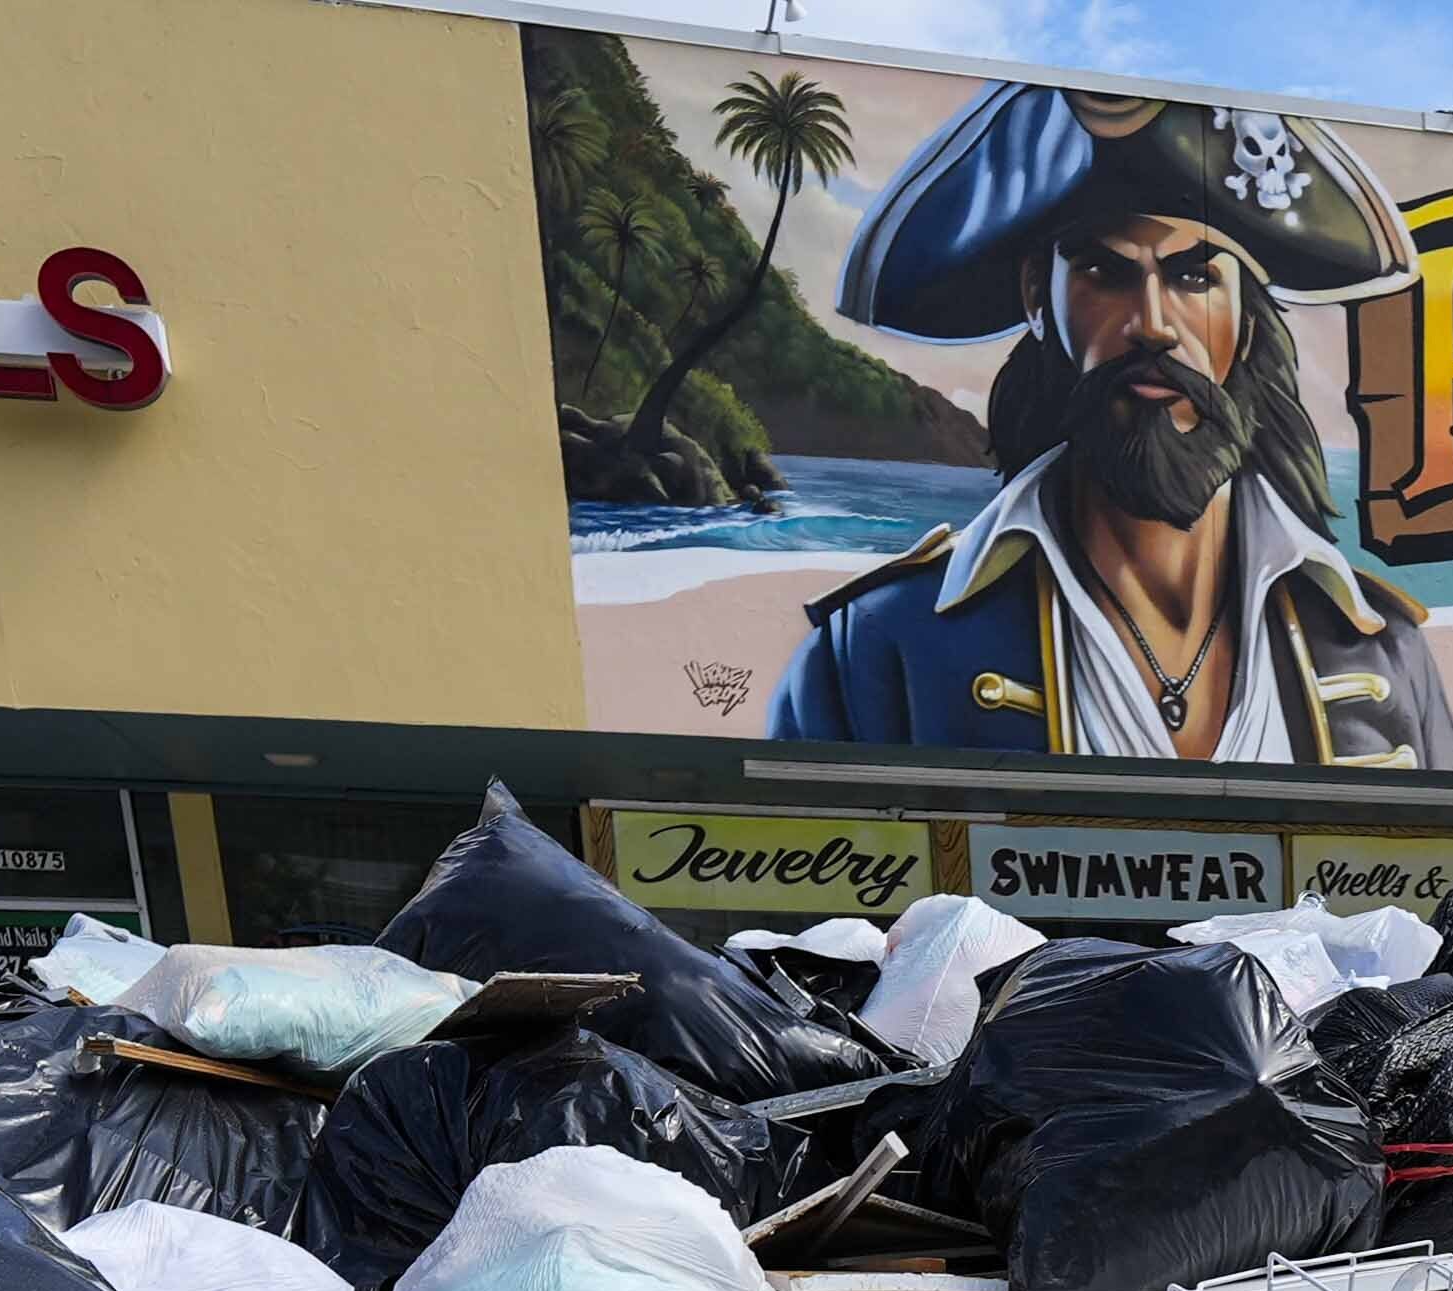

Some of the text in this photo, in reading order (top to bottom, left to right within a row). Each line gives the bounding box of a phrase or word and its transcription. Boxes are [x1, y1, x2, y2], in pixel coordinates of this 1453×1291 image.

[0, 851, 64, 870] 10875
[633, 823, 918, 908] Jewelry
[990, 847, 1267, 903] SWIMWEAR
[1306, 859, 1412, 898] Shells
[1414, 865, 1449, 899] &
[14, 926, 48, 947] Nails
